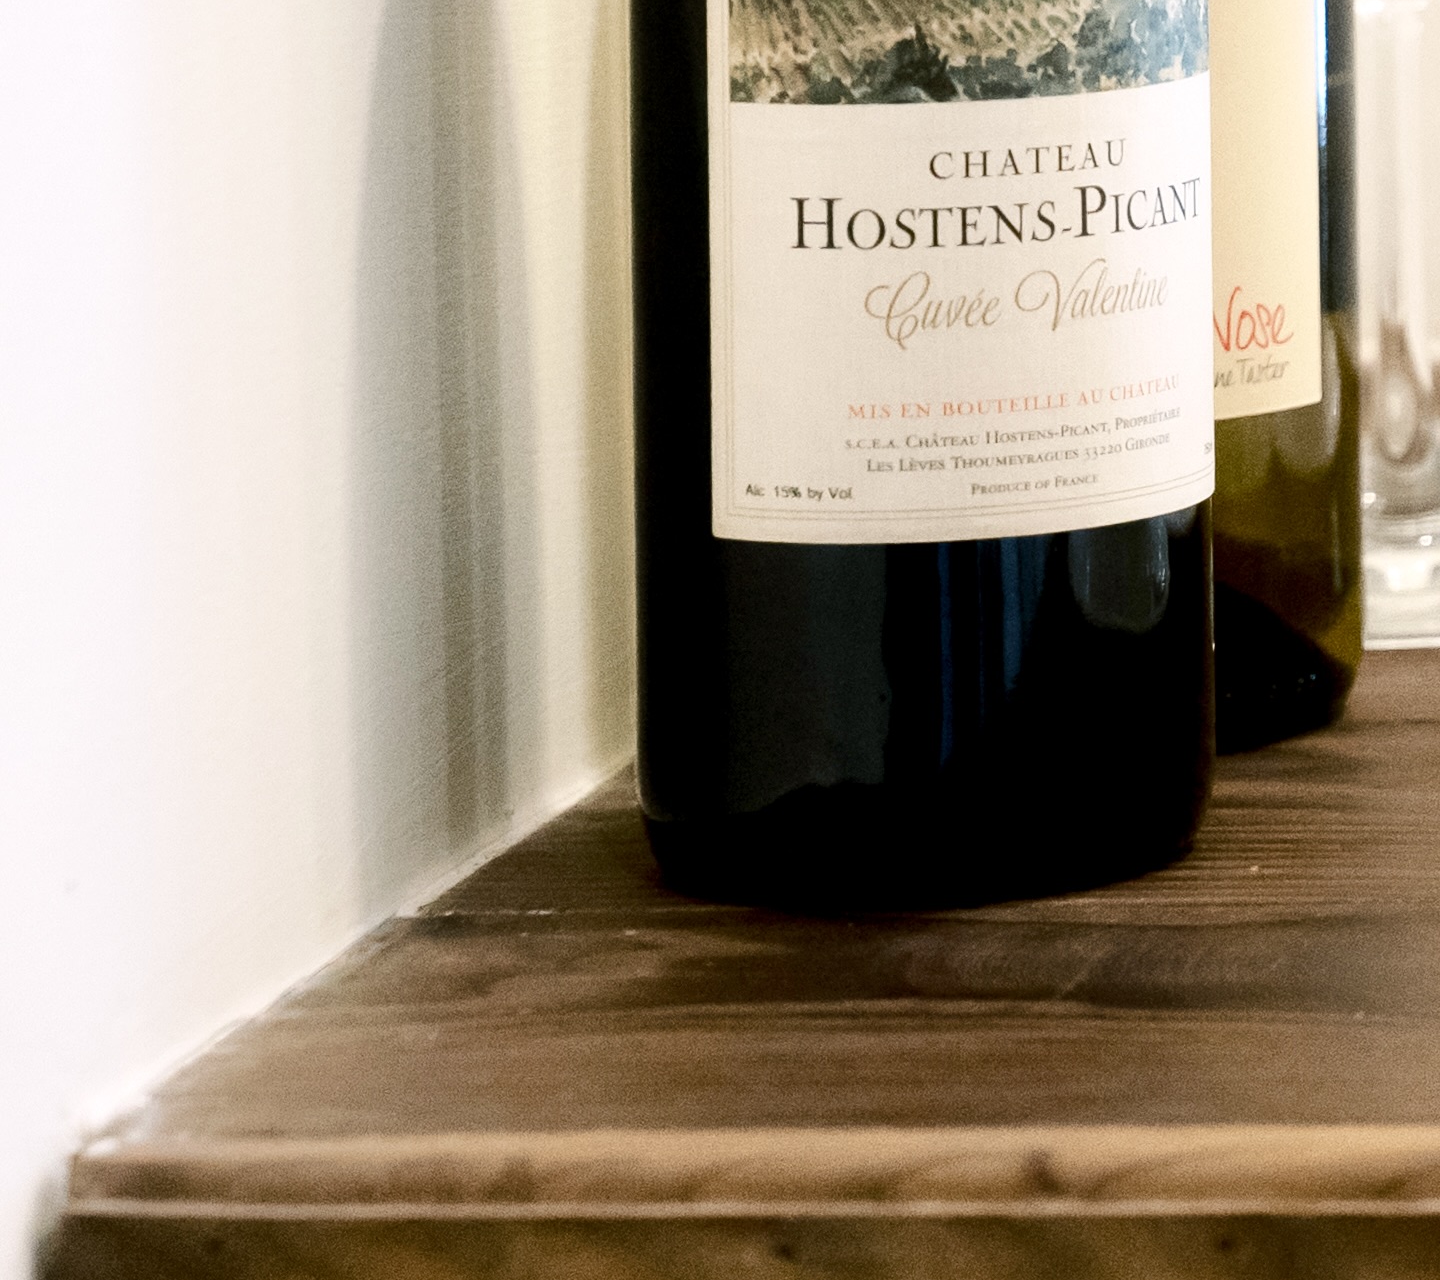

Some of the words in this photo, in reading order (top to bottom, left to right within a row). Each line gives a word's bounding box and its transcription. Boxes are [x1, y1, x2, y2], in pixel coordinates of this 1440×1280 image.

[929, 138, 1126, 180] CHATEAU
[864, 271, 1001, 350] Cuvée
[1014, 258, 1169, 332] Valentine
[847, 403, 892, 419] MIS
[901, 402, 931, 419] EN
[942, 392, 1070, 417] BOUTEILLE
[1078, 389, 1102, 406] AU
[807, 486, 825, 502] by
